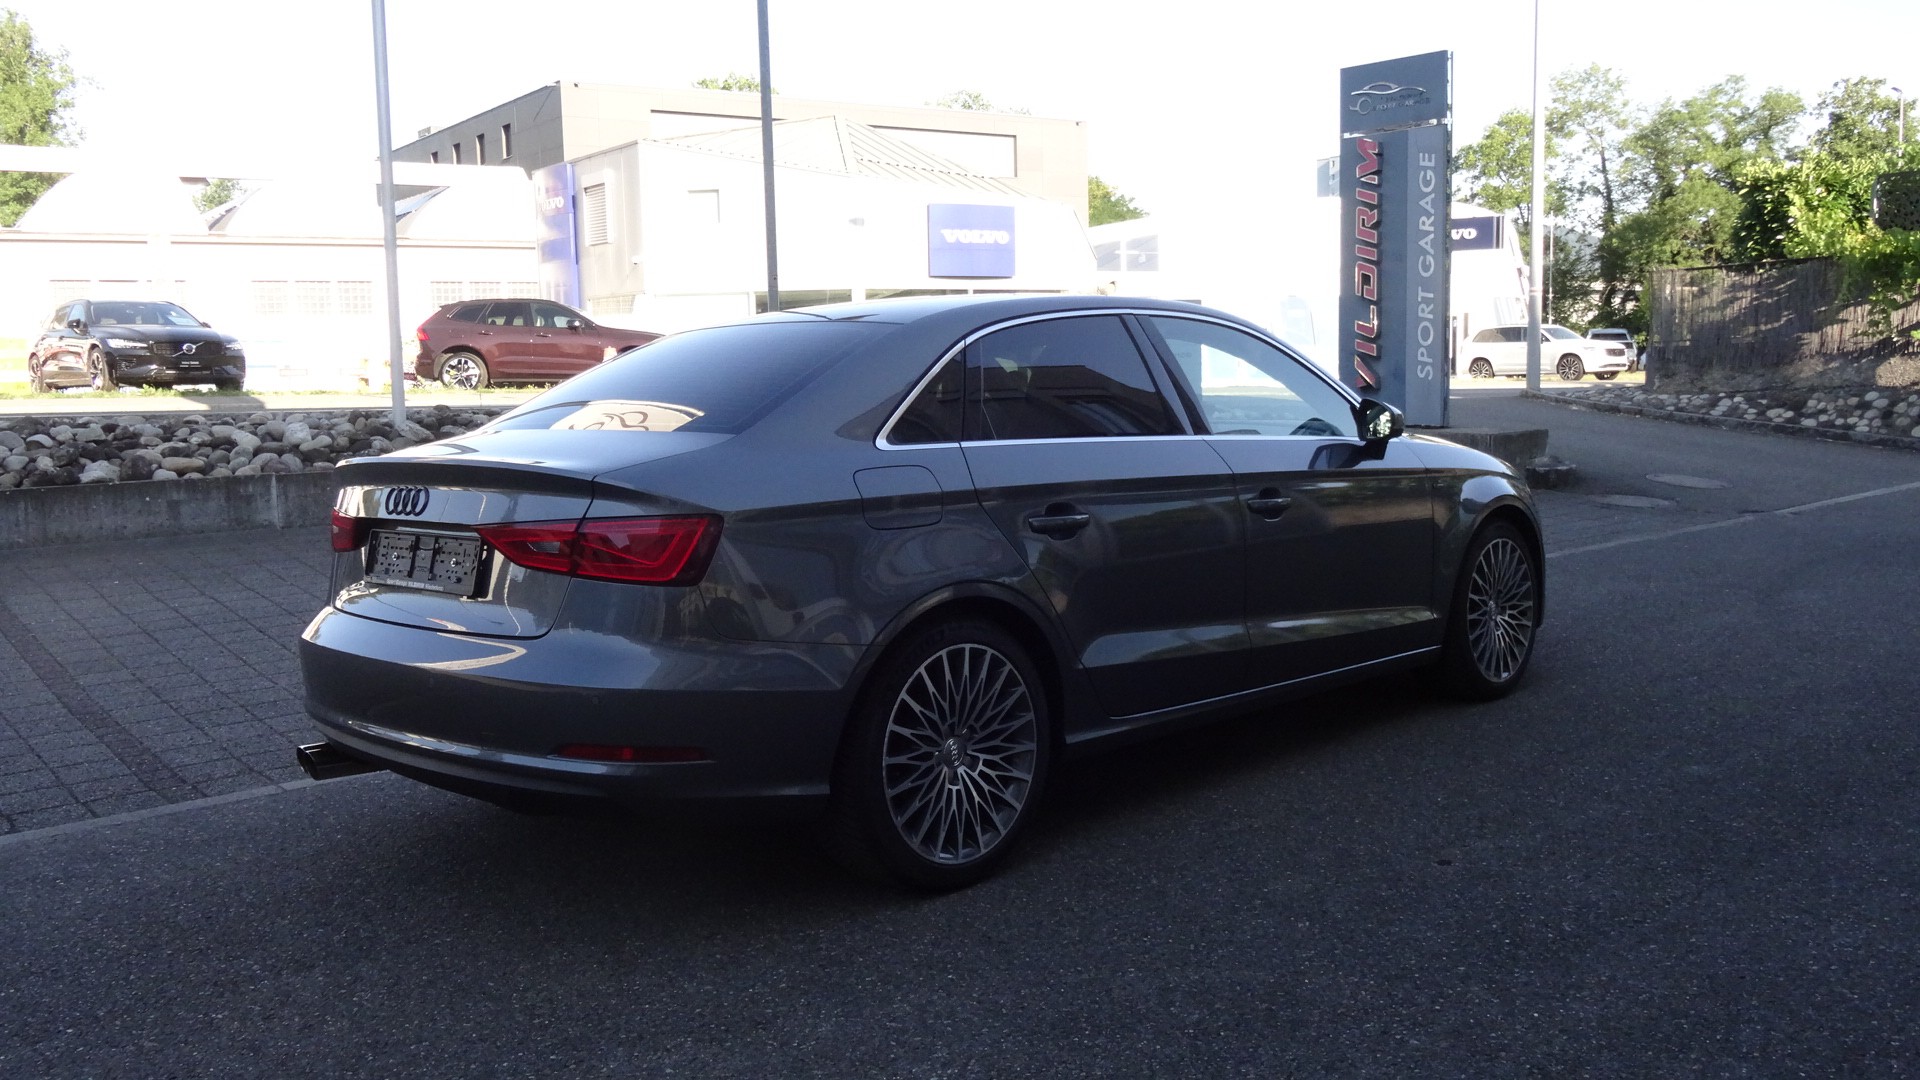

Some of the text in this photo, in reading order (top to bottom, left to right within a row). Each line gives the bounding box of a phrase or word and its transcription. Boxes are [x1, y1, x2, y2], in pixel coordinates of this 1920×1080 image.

[940, 228, 1010, 245] VOLVO
[1417, 153, 1435, 381] SPORT GARAGE
